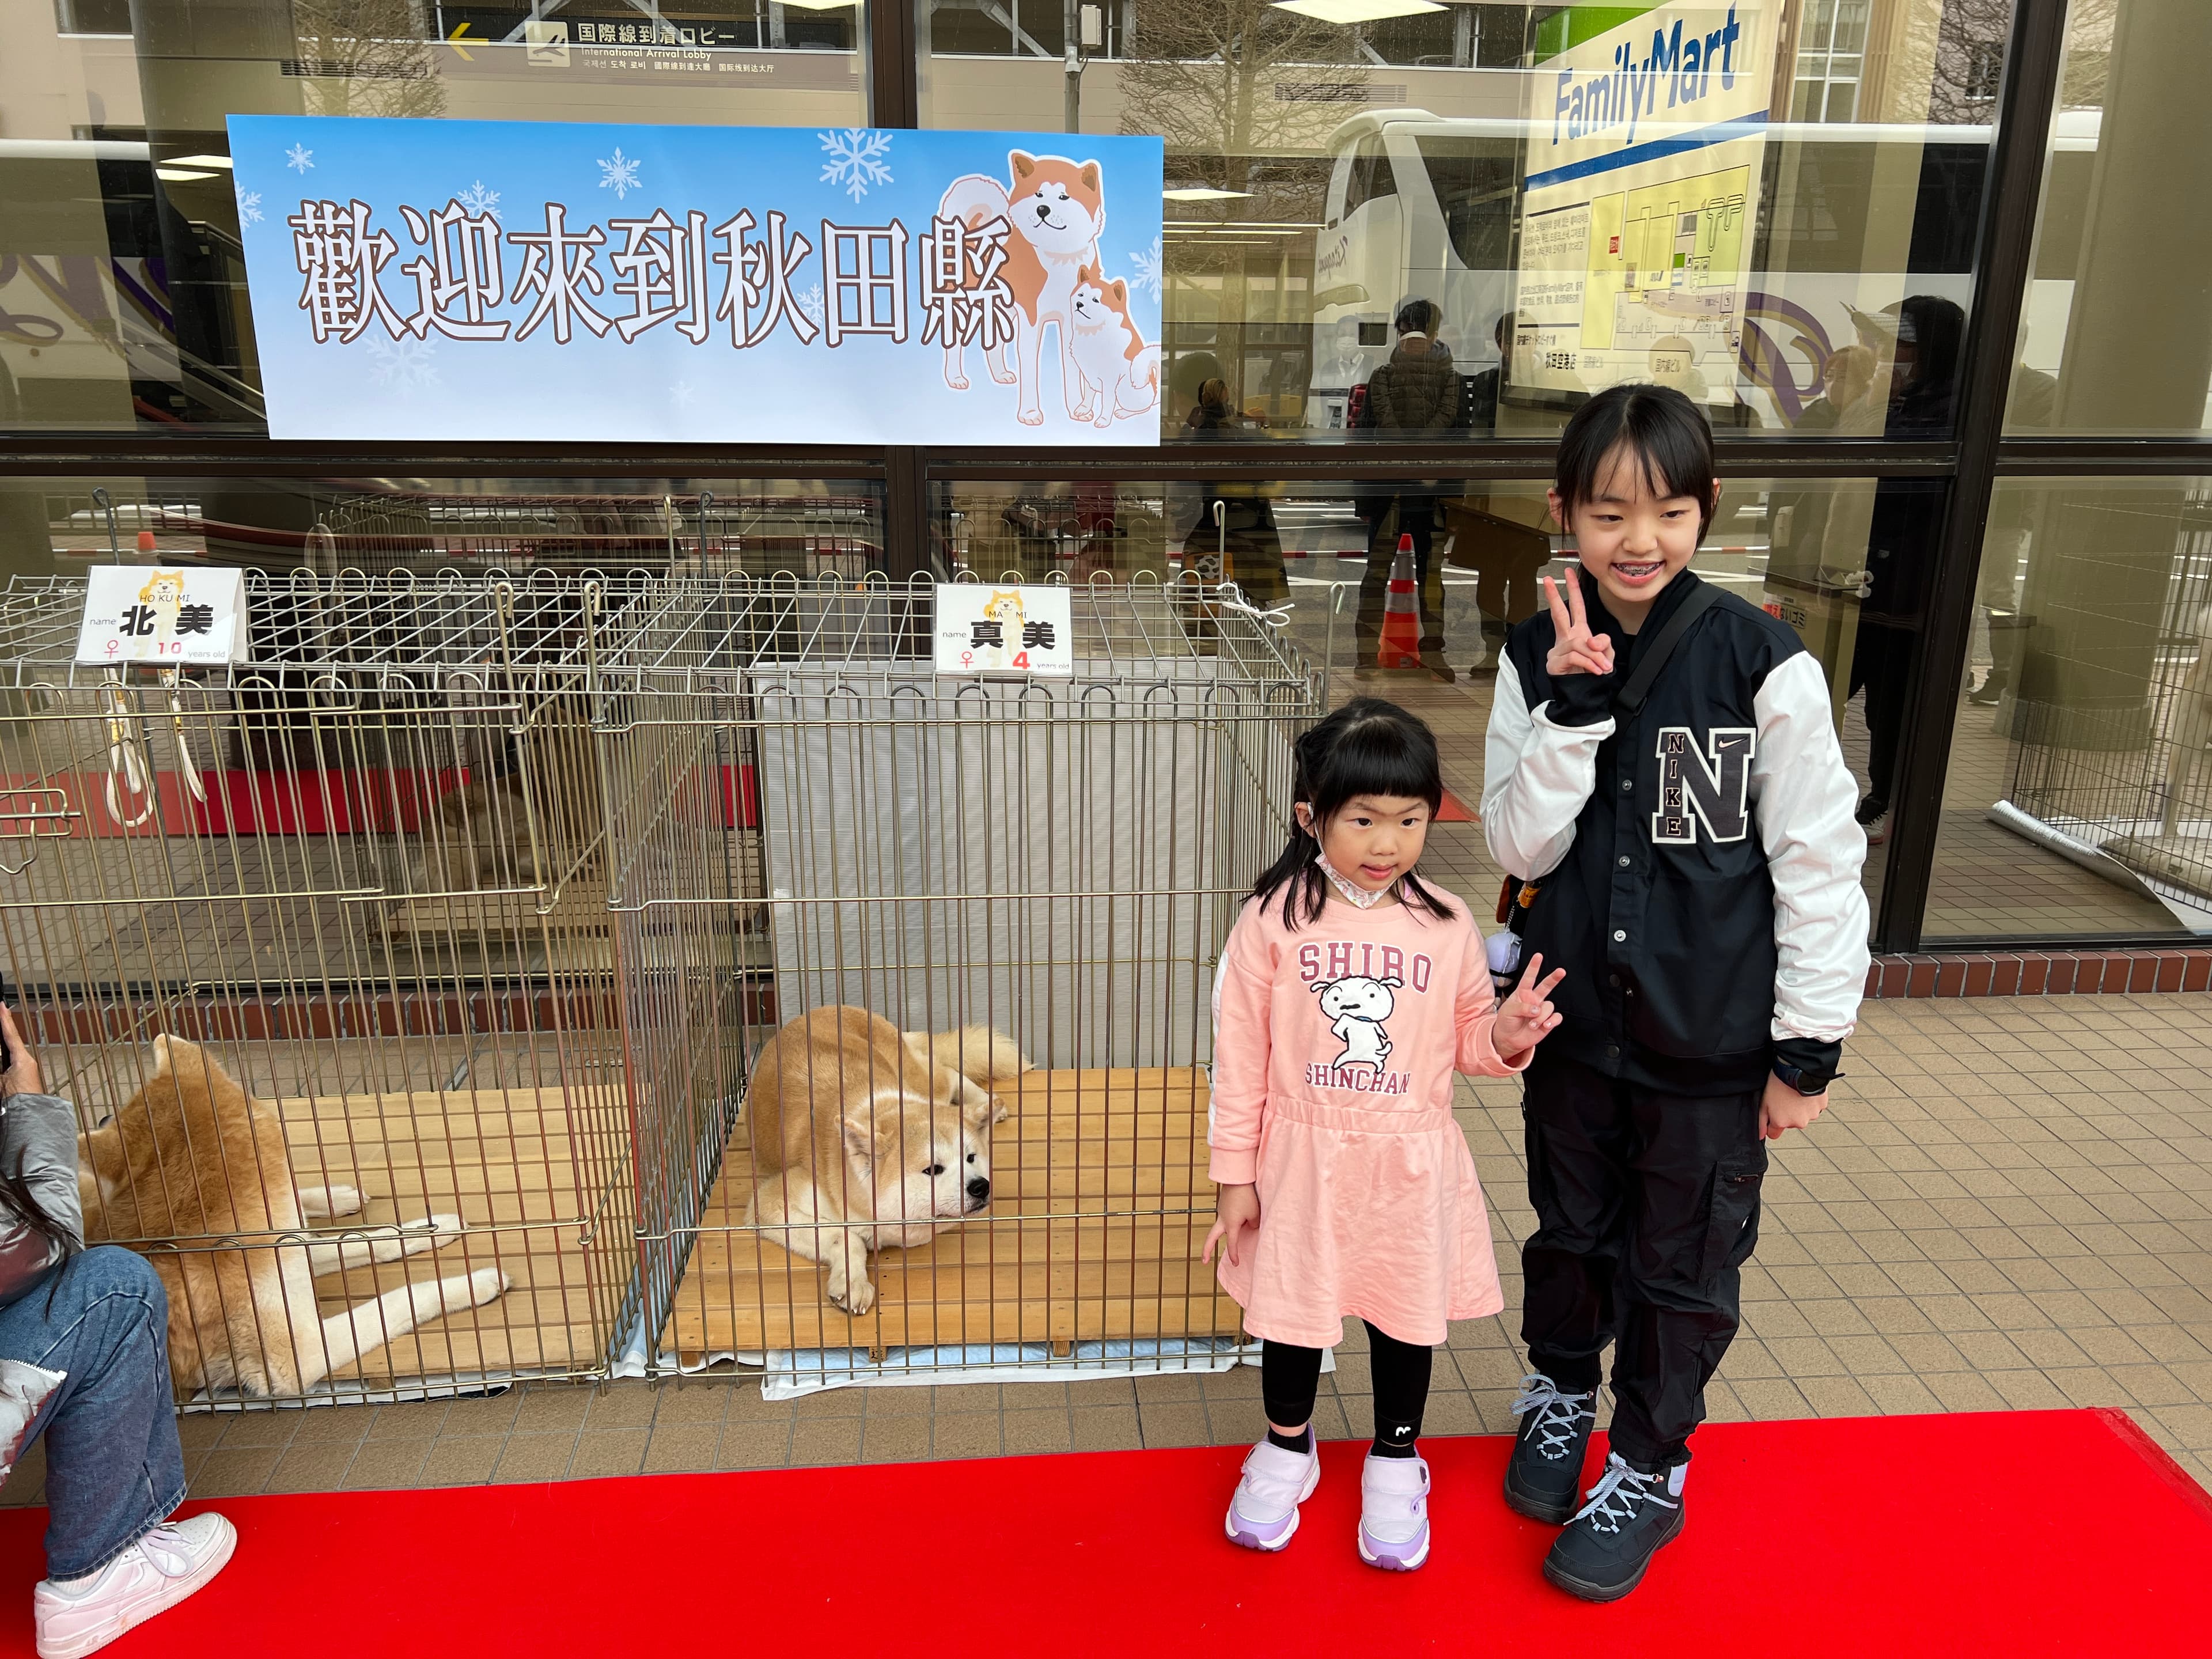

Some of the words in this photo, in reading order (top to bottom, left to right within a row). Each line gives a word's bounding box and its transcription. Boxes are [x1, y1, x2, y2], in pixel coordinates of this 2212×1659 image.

[578, 22, 735, 45] 国際線到着ロビー
[581, 47, 643, 58] International
[646, 49, 680, 58] Arrival
[683, 50, 712, 61] Lobby
[611, 60, 626, 69] 도착
[630, 61, 646, 69] 로비
[1553, 5, 1740, 146] FamilyMart
[288, 198, 1016, 350] 歡迎來到秋田縣
[139, 594, 154, 603] HO
[1013, 652, 1030, 669] 4
[1652, 727, 1756, 844] N
[1665, 734, 1684, 836] NIKE
[1298, 941, 1431, 993] SHIRO
[1305, 1061, 1411, 1094] SHINCHAN
